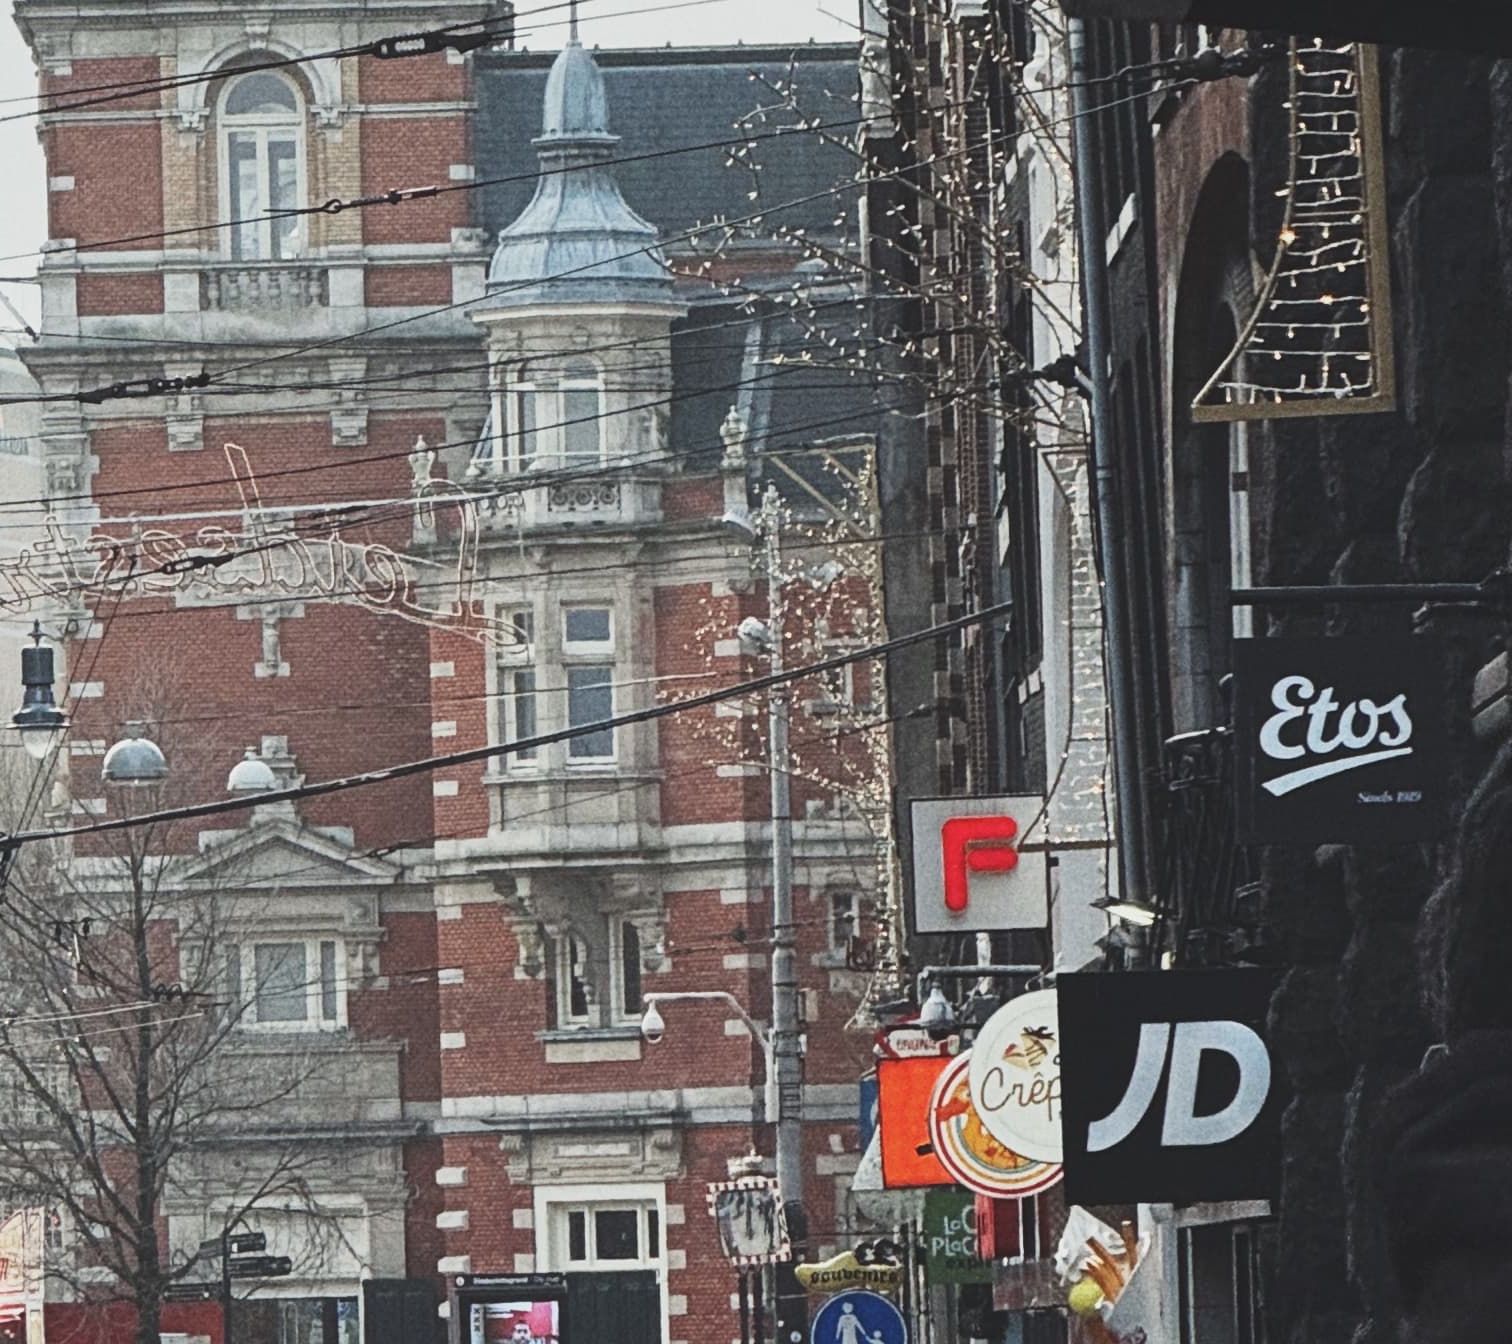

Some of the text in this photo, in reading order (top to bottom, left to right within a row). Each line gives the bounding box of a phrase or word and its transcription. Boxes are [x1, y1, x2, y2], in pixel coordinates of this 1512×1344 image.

[1259, 675, 1413, 759] Etos
[941, 815, 1018, 912] F
[1087, 1020, 1271, 1152] JD
